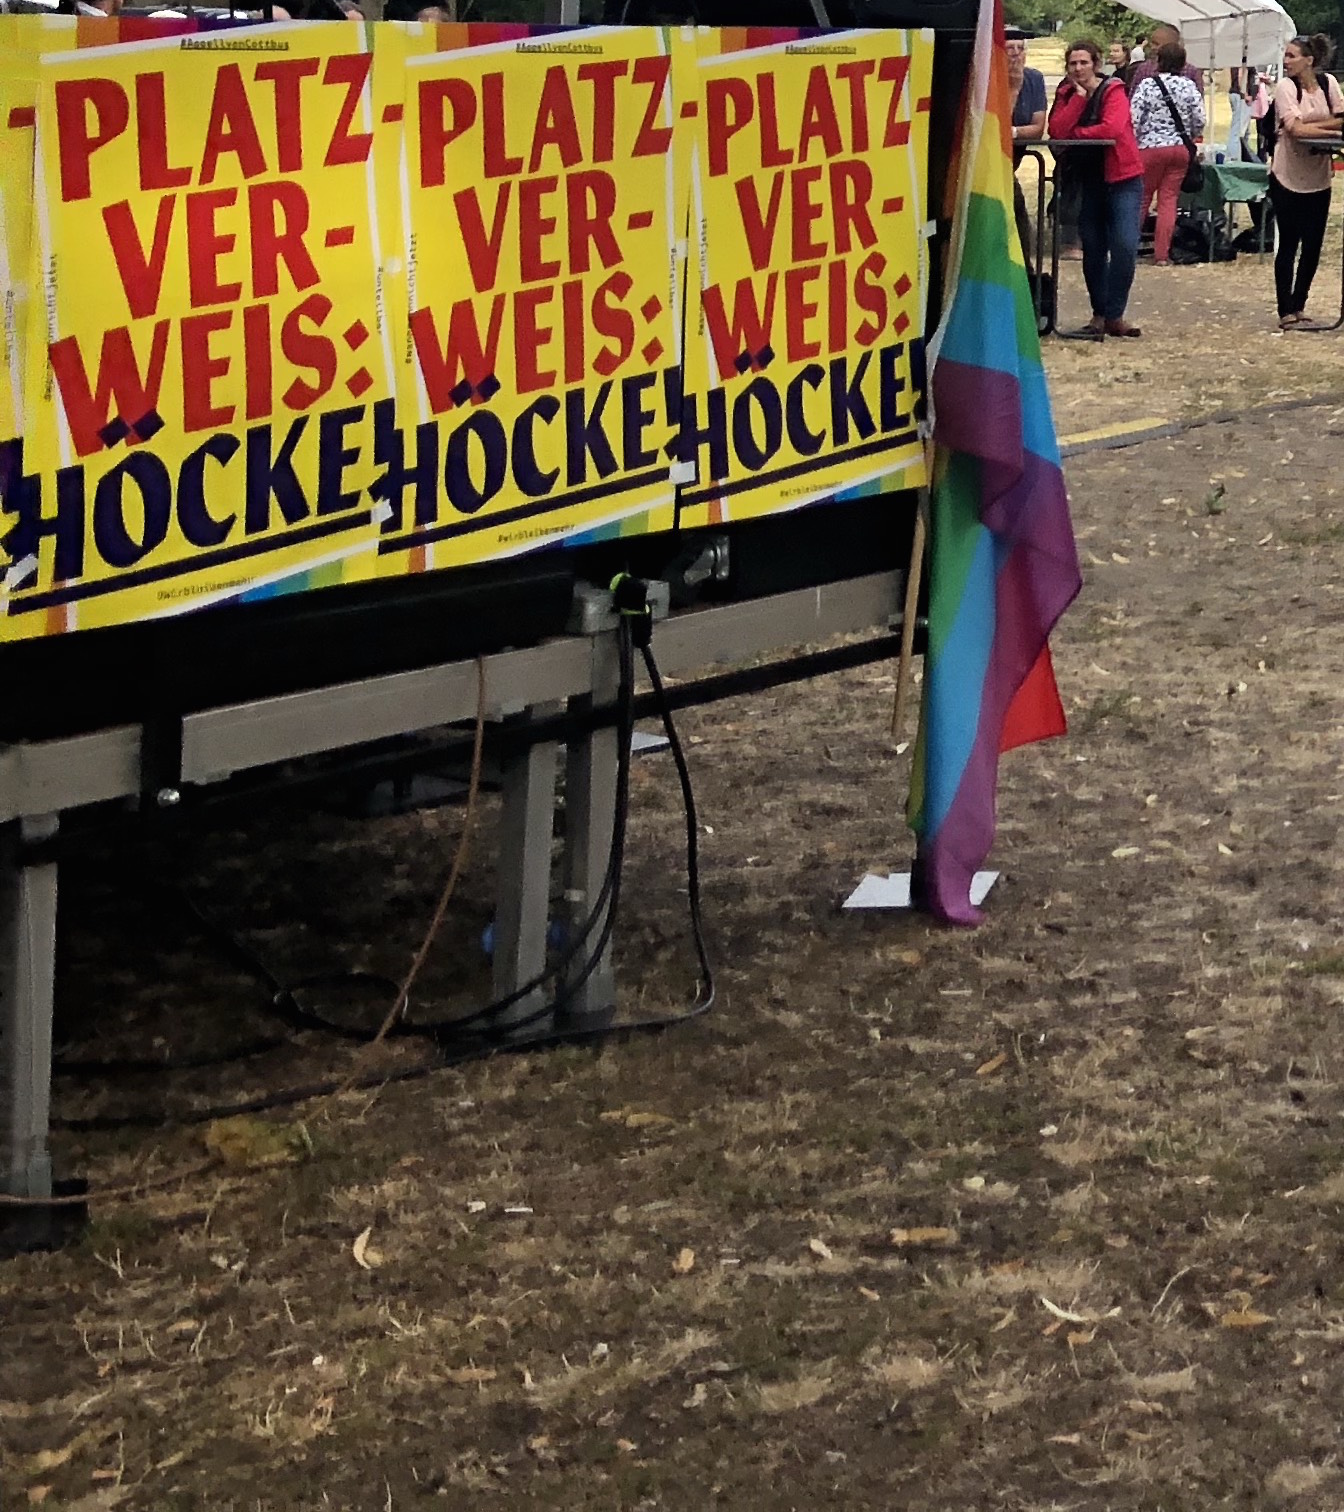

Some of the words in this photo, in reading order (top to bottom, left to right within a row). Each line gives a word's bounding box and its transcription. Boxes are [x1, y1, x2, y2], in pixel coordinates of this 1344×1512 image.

[55, 52, 403, 202] PLATZ-
[418, 55, 698, 188] PLATZ-
[706, 55, 931, 177] PLATZ-
[102, 180, 355, 320] VER-
[453, 169, 653, 293] VER-
[734, 159, 904, 272] VER-
[49, 293, 375, 457] WEIS:
[408, 270, 664, 415] WEIS:
[701, 251, 912, 381] WEIS:
[677, 337, 928, 489] HÖCKE!
